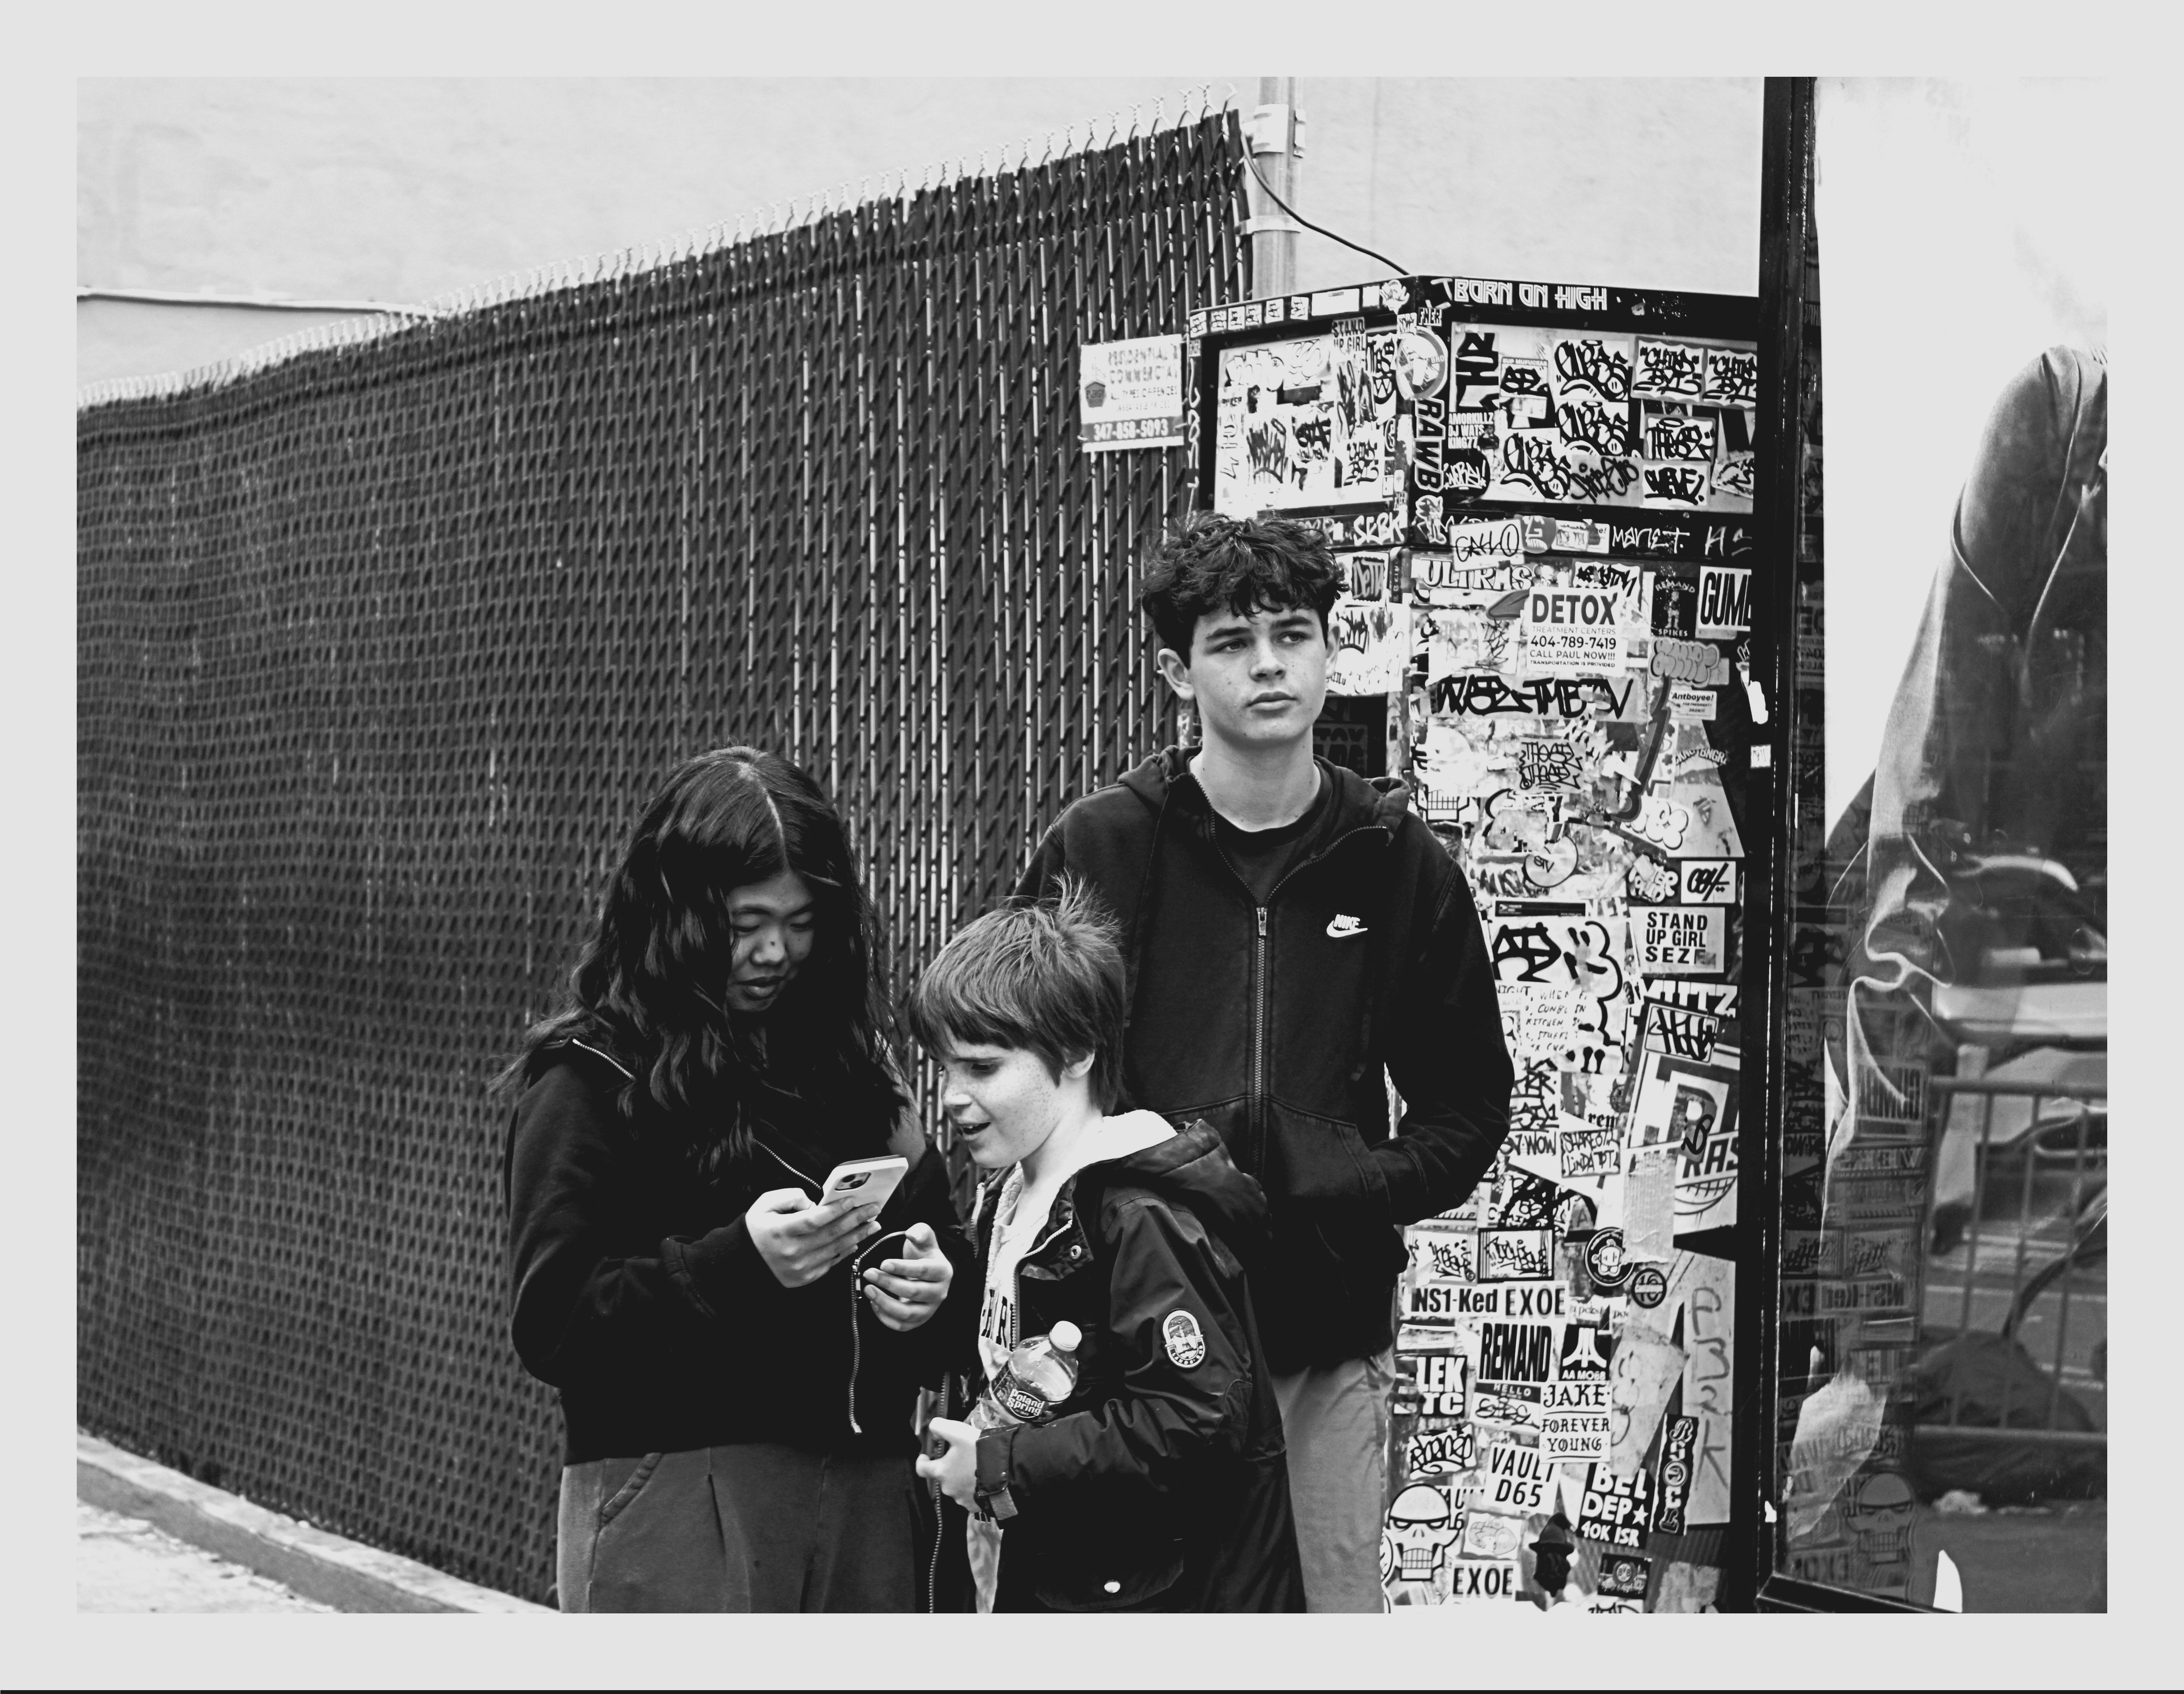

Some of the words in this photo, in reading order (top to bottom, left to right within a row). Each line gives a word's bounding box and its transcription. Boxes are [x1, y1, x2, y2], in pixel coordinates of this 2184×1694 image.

[1455, 278, 1512, 305] BORN
[1519, 283, 1548, 308] ON
[1555, 286, 1607, 310] HIGH
[1448, 412, 1494, 425] AMORKILLZ
[1448, 425, 1458, 436] DJ
[1461, 425, 1485, 436] WATS
[1448, 437, 1478, 449] KING77
[1655, 578, 1696, 594] REMAND
[1532, 592, 1618, 625] DETOX
[1700, 572, 1752, 626] GUM
[1532, 626, 1579, 634] TREATMENT
[1581, 627, 1616, 635] CENTERS
[1659, 628, 1688, 636] SPIKES
[1530, 635, 1616, 650] 404-789-7419
[1530, 650, 1553, 658] CALL
[1556, 650, 1581, 659] PAUL
[1583, 651, 1615, 660] NOW!!!
[1672, 692, 1714, 702] Antboyee!
[1333, 914, 1360, 930] NIKE
[1647, 911, 1708, 930] STAND
[1646, 928, 1666, 945] UP
[1672, 930, 1706, 948] GIRL
[1505, 1287, 1566, 1318] EXOE
[1479, 1323, 1552, 1383] REMAND
[1562, 1370, 1576, 1380] AA
[1009, 1388, 1045, 1409] Poland
[1493, 1383, 1531, 1397] HELLO
[1543, 1384, 1607, 1407] JAKE
[1006, 1396, 1042, 1416] Spring
[1541, 1418, 1610, 1433] FOREVER
[1547, 1437, 1602, 1452] YOUNG
[1491, 1447, 1554, 1482] VAULT
[1495, 1479, 1542, 1507] D65
[1581, 1491, 1633, 1525] DEP
[1581, 1520, 1610, 1541] 40K
[1614, 1526, 1639, 1547] ISR
[1453, 1566, 1514, 1597] EXOE
